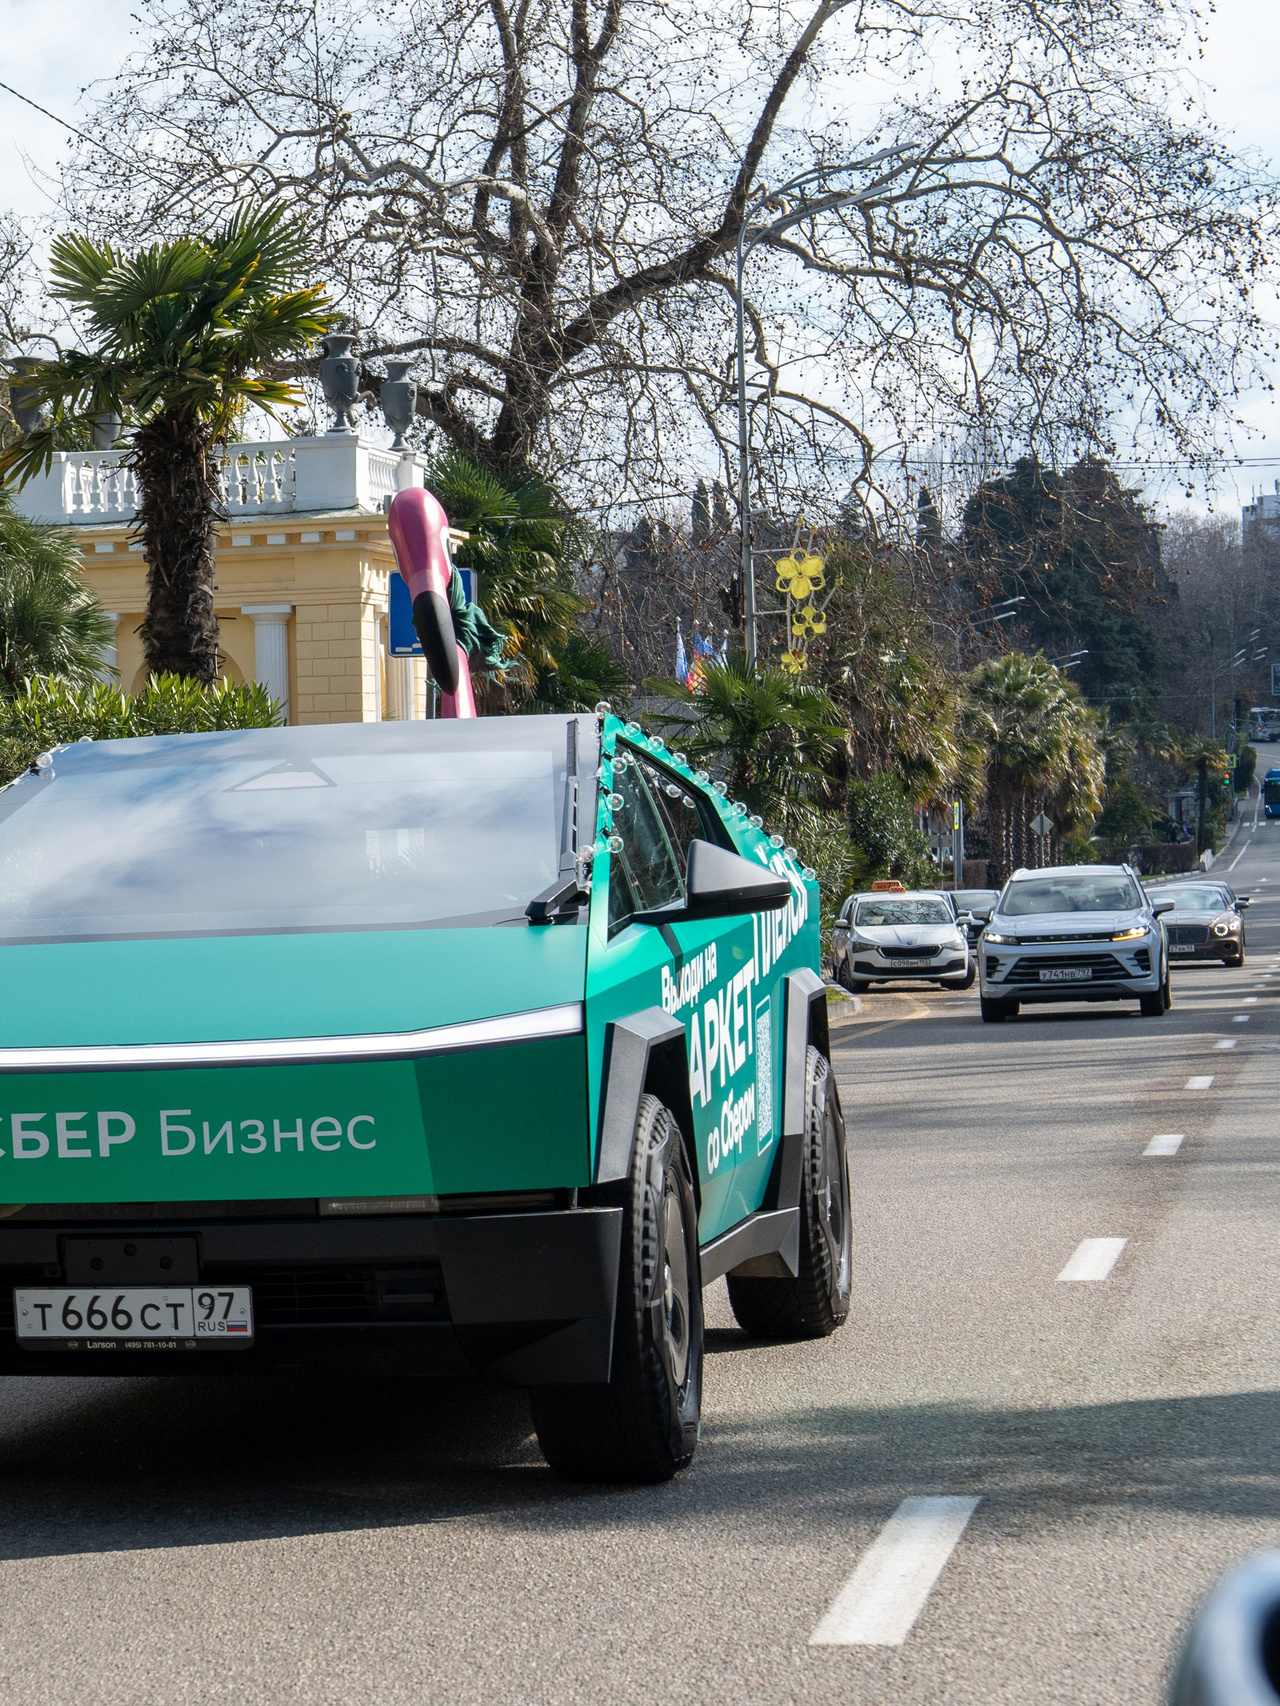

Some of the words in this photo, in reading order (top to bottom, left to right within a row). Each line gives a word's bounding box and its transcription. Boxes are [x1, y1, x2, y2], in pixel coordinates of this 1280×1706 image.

[661, 951, 704, 1014] Выходи
[705, 941, 717, 985] на
[159, 1108, 376, 1156] Бизнес
[707, 1126, 720, 1175] со
[720, 1083, 755, 1158] Сбером
[197, 1292, 235, 1320] 97
[86, 1340, 117, 1349] Larson
[124, 1341, 142, 1350] (495)
[198, 1321, 226, 1332] RUS
